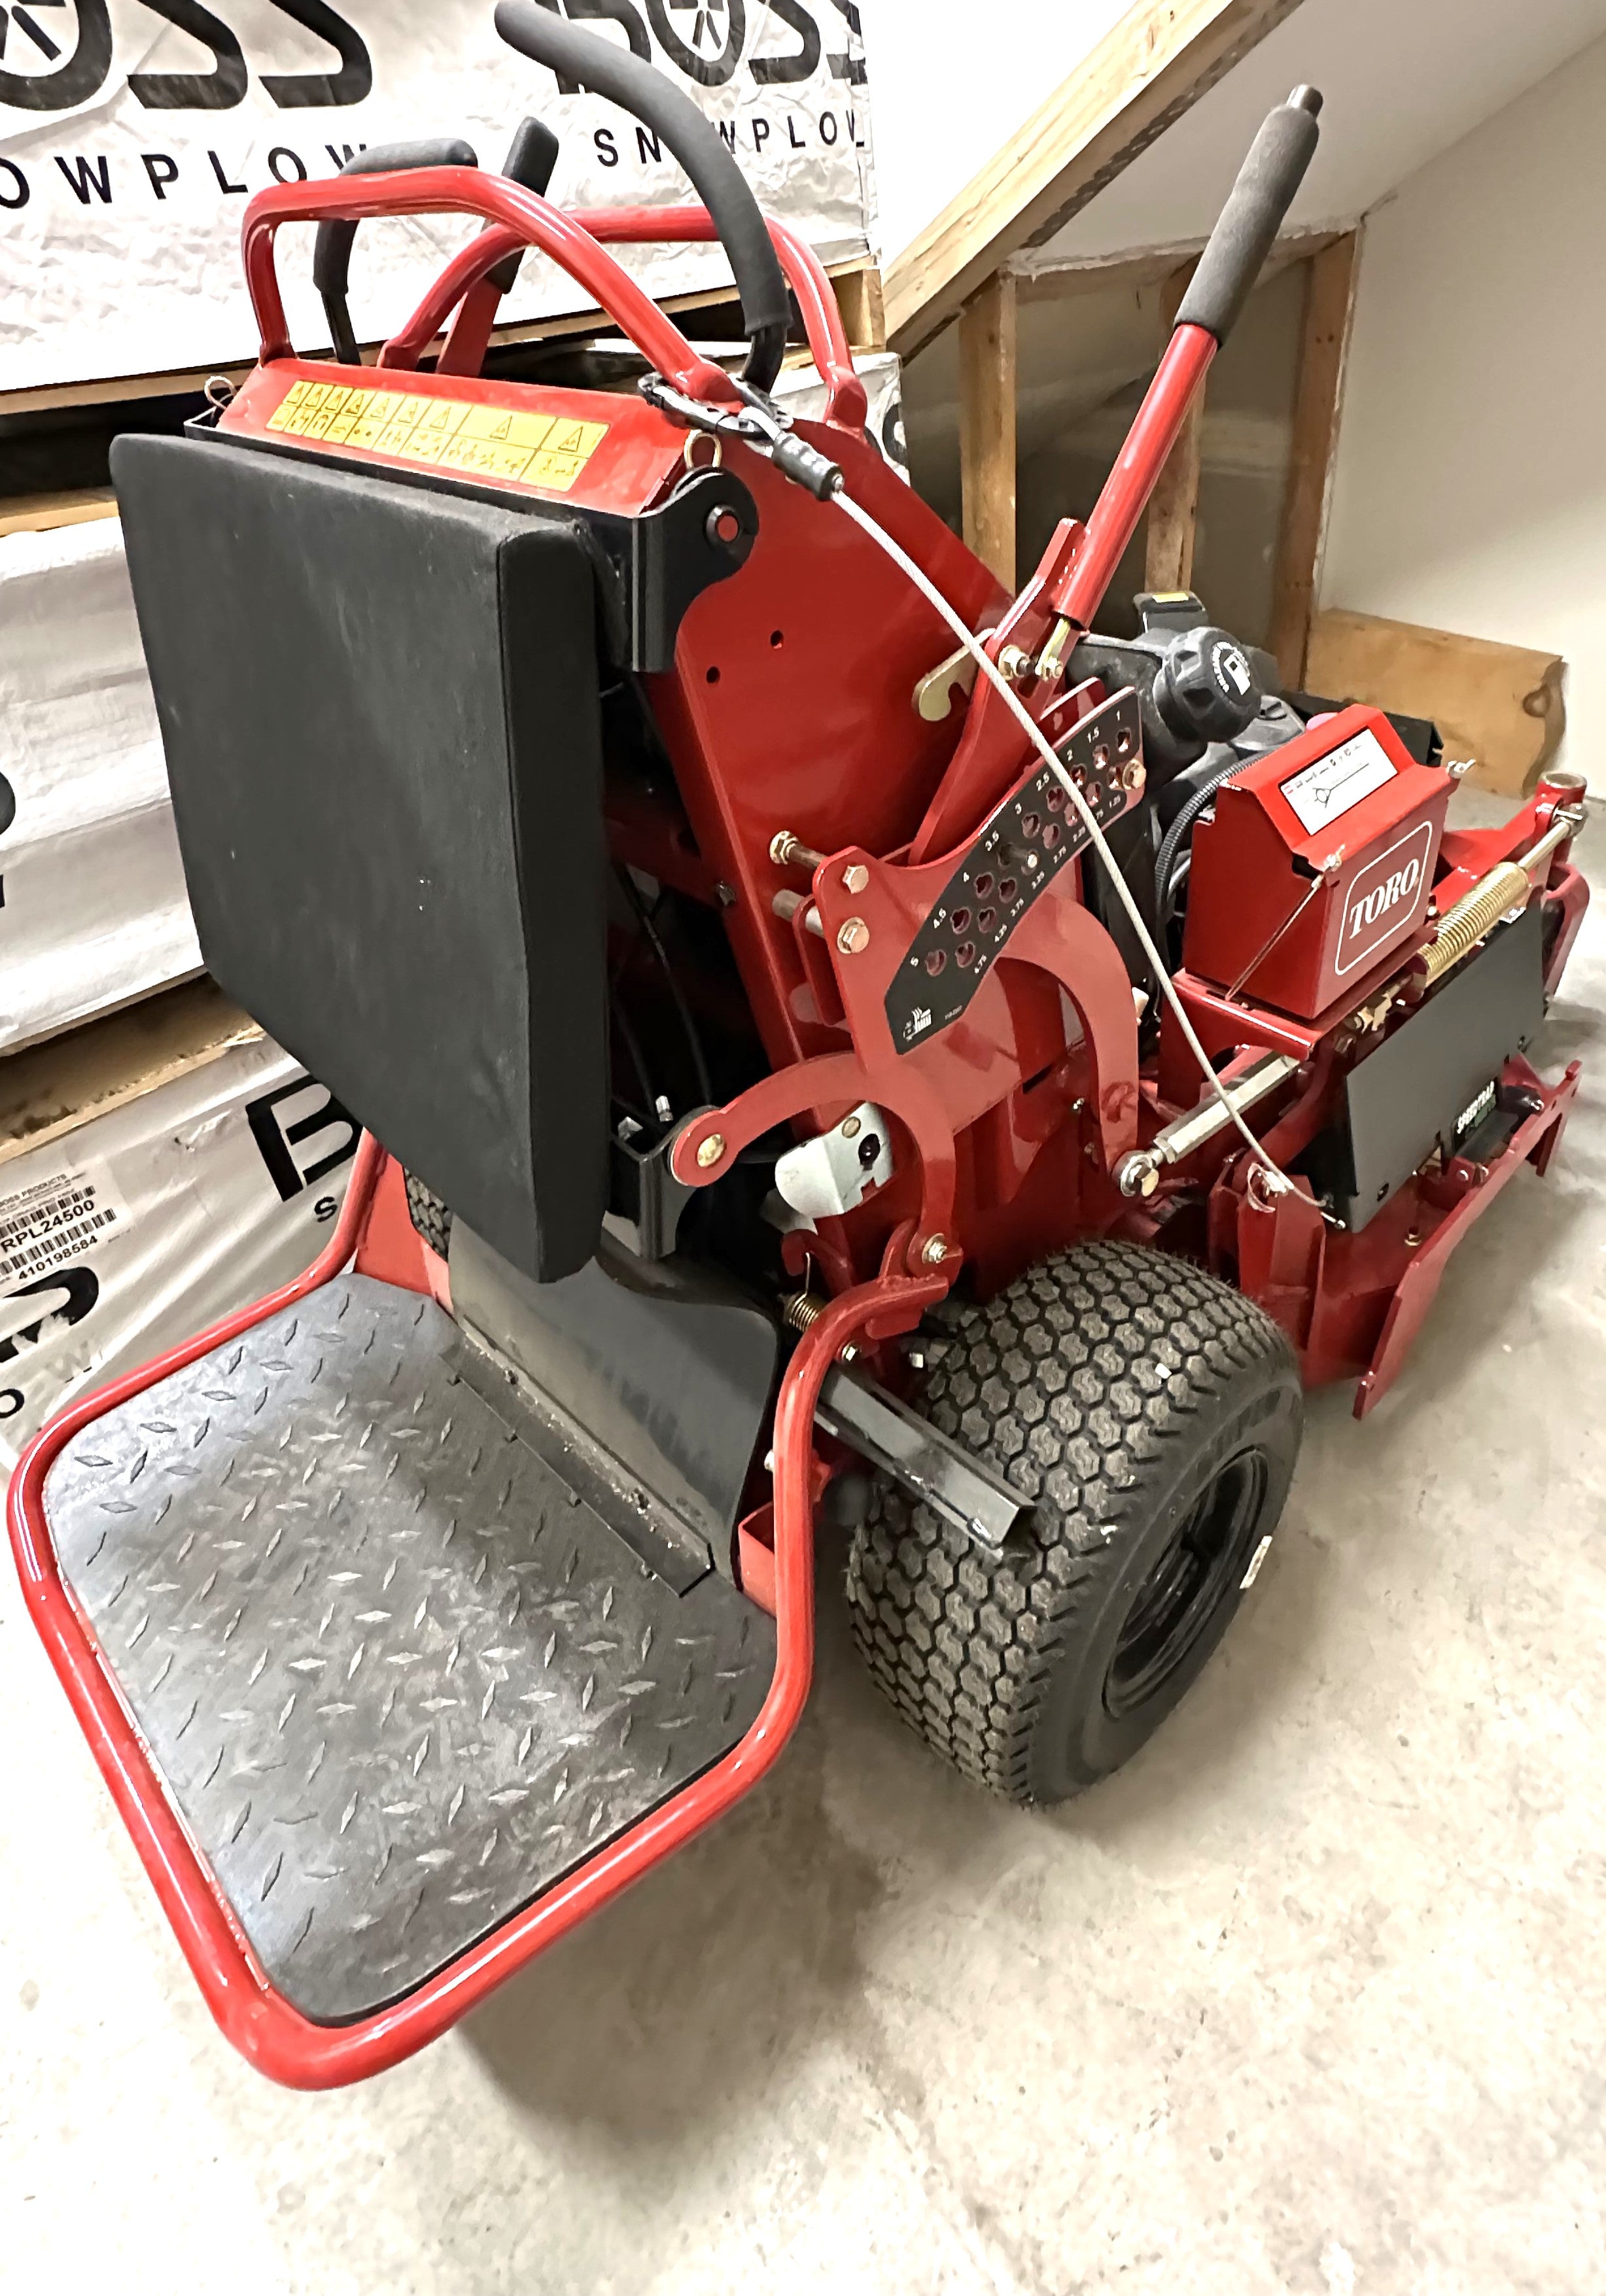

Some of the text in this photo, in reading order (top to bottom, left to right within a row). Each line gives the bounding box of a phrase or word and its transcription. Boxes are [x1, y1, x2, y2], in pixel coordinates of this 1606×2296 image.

[1116, 710, 1121, 721] 1
[1015, 803, 1022, 814] 3
[1349, 858, 1419, 940] TORO
[1, 1200, 94, 1253] RPL24500
[18, 1235, 98, 1279] 410198584
